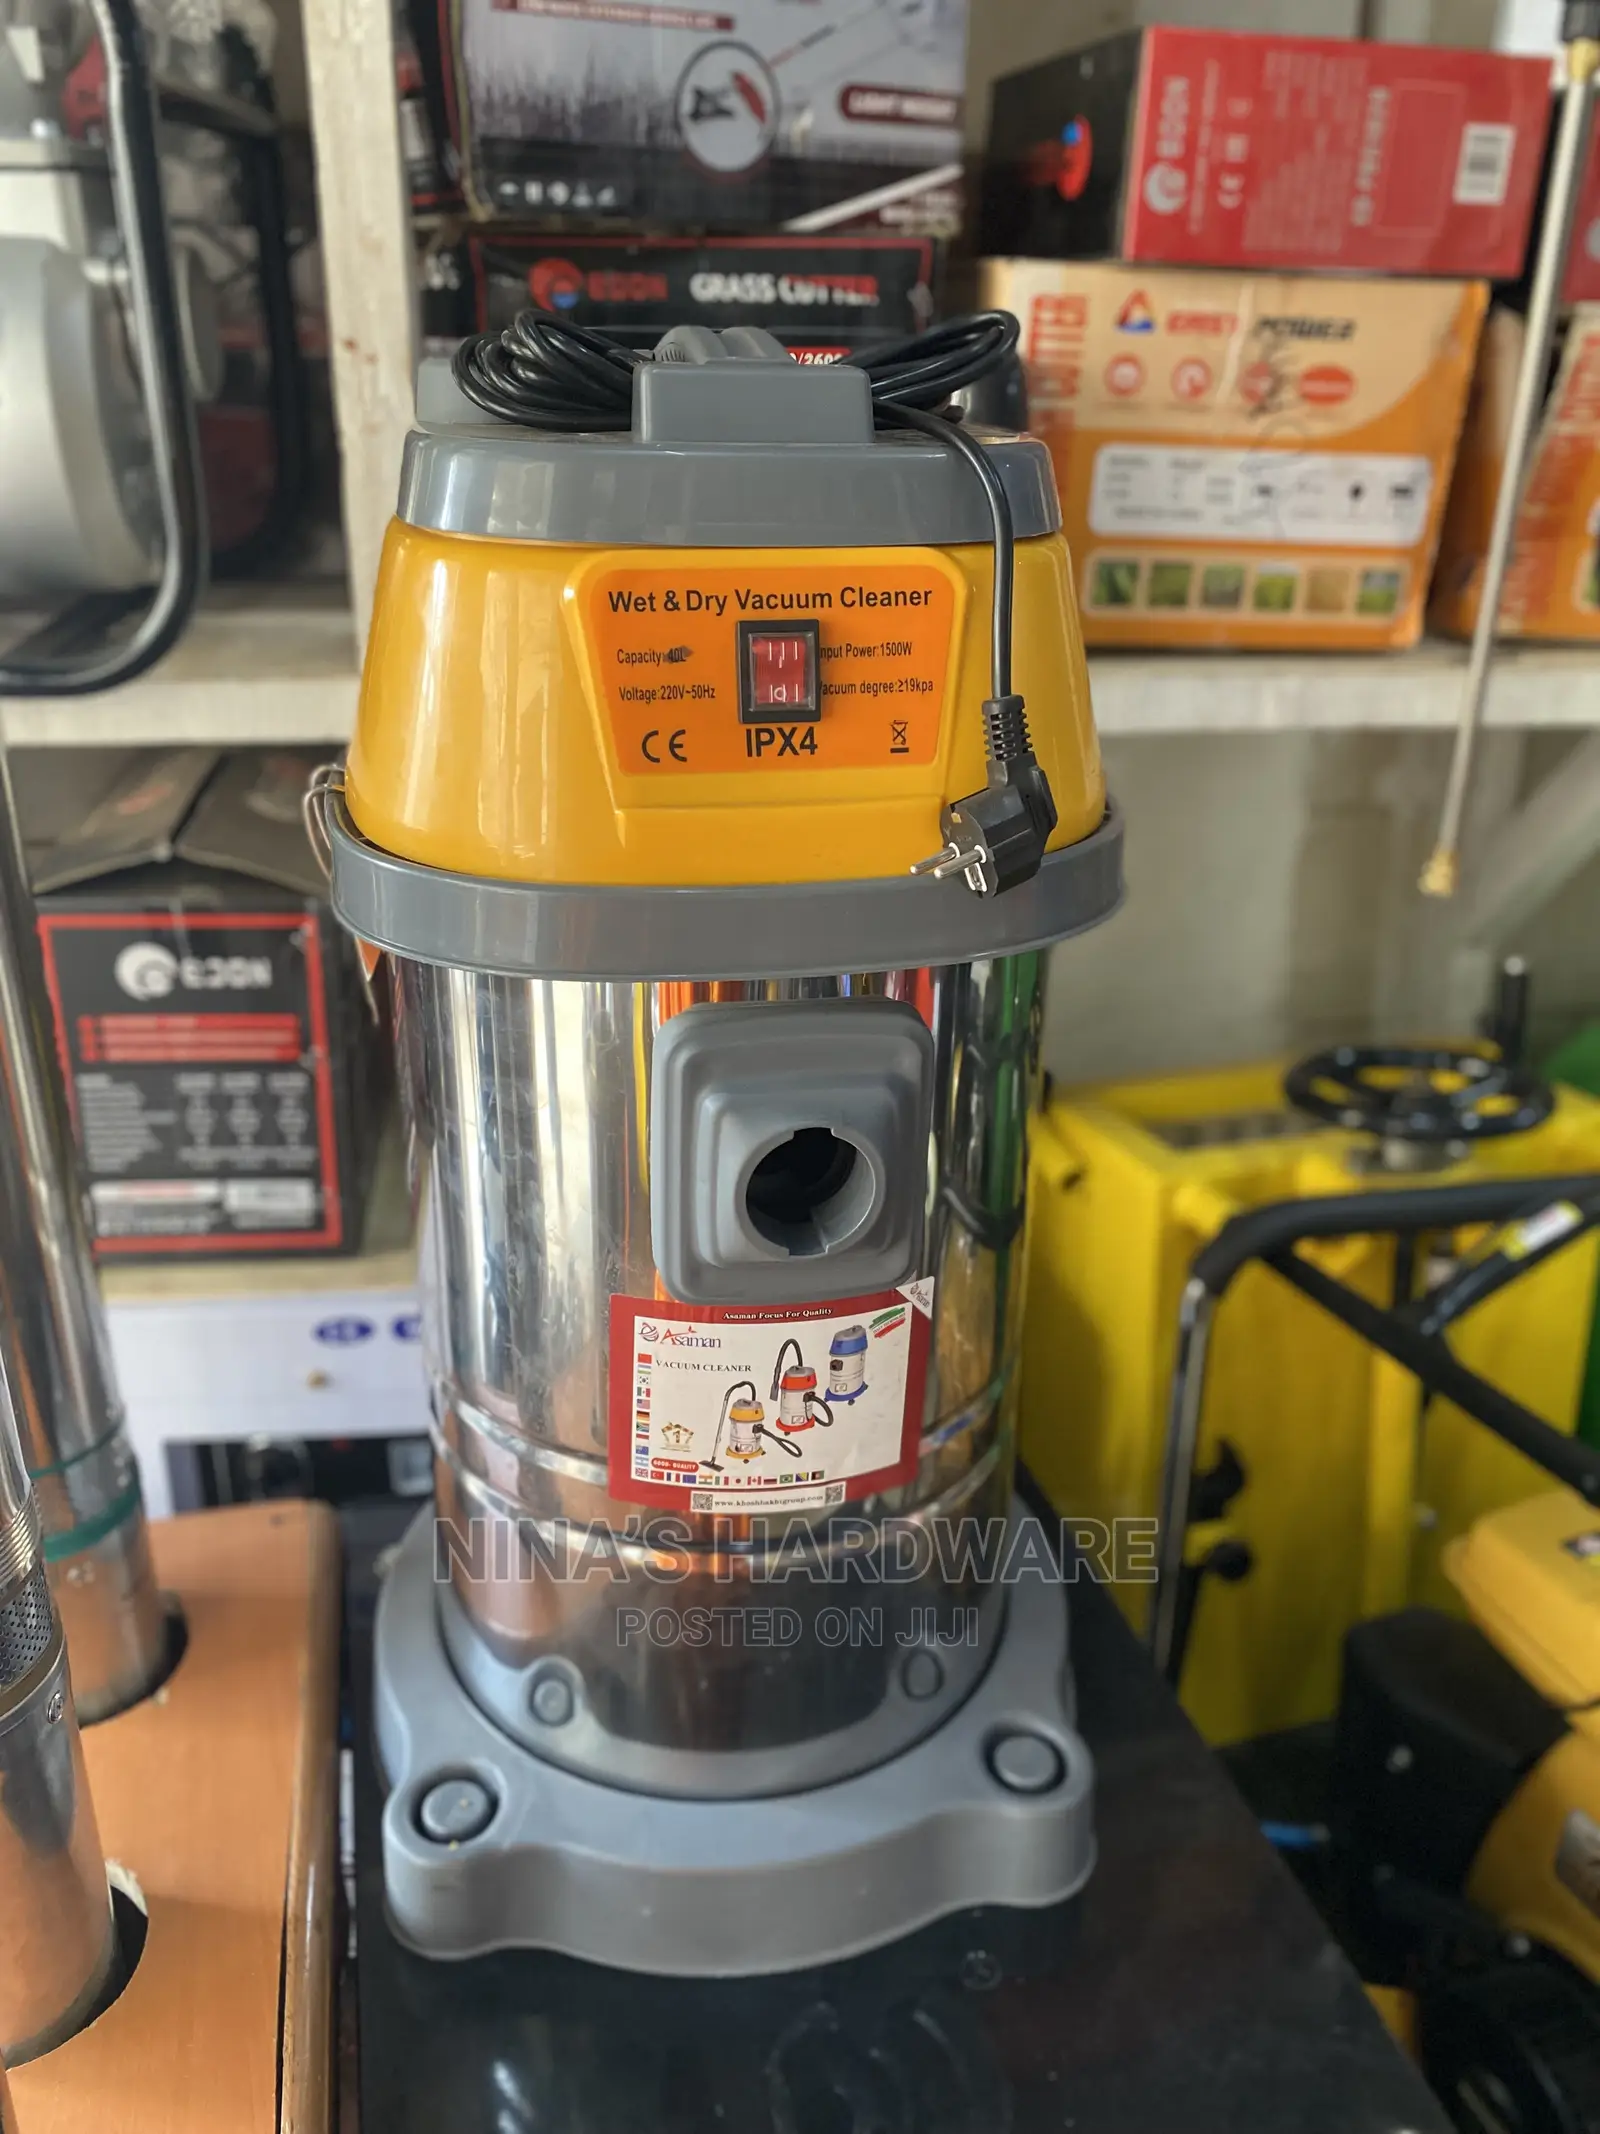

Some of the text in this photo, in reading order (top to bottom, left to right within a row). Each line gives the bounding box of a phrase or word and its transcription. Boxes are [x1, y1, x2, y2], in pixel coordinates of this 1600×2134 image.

[608, 586, 933, 616] Wet & Dry Vacuum Cleaner
[819, 645, 842, 661] nput
[641, 729, 687, 763] CE
[745, 727, 818, 758] IPX4
[723, 1308, 833, 1320] Asaman Focus For Quality
[660, 1326, 721, 1349] Asaman
[656, 1360, 752, 1373] VACUUM CLEANER
